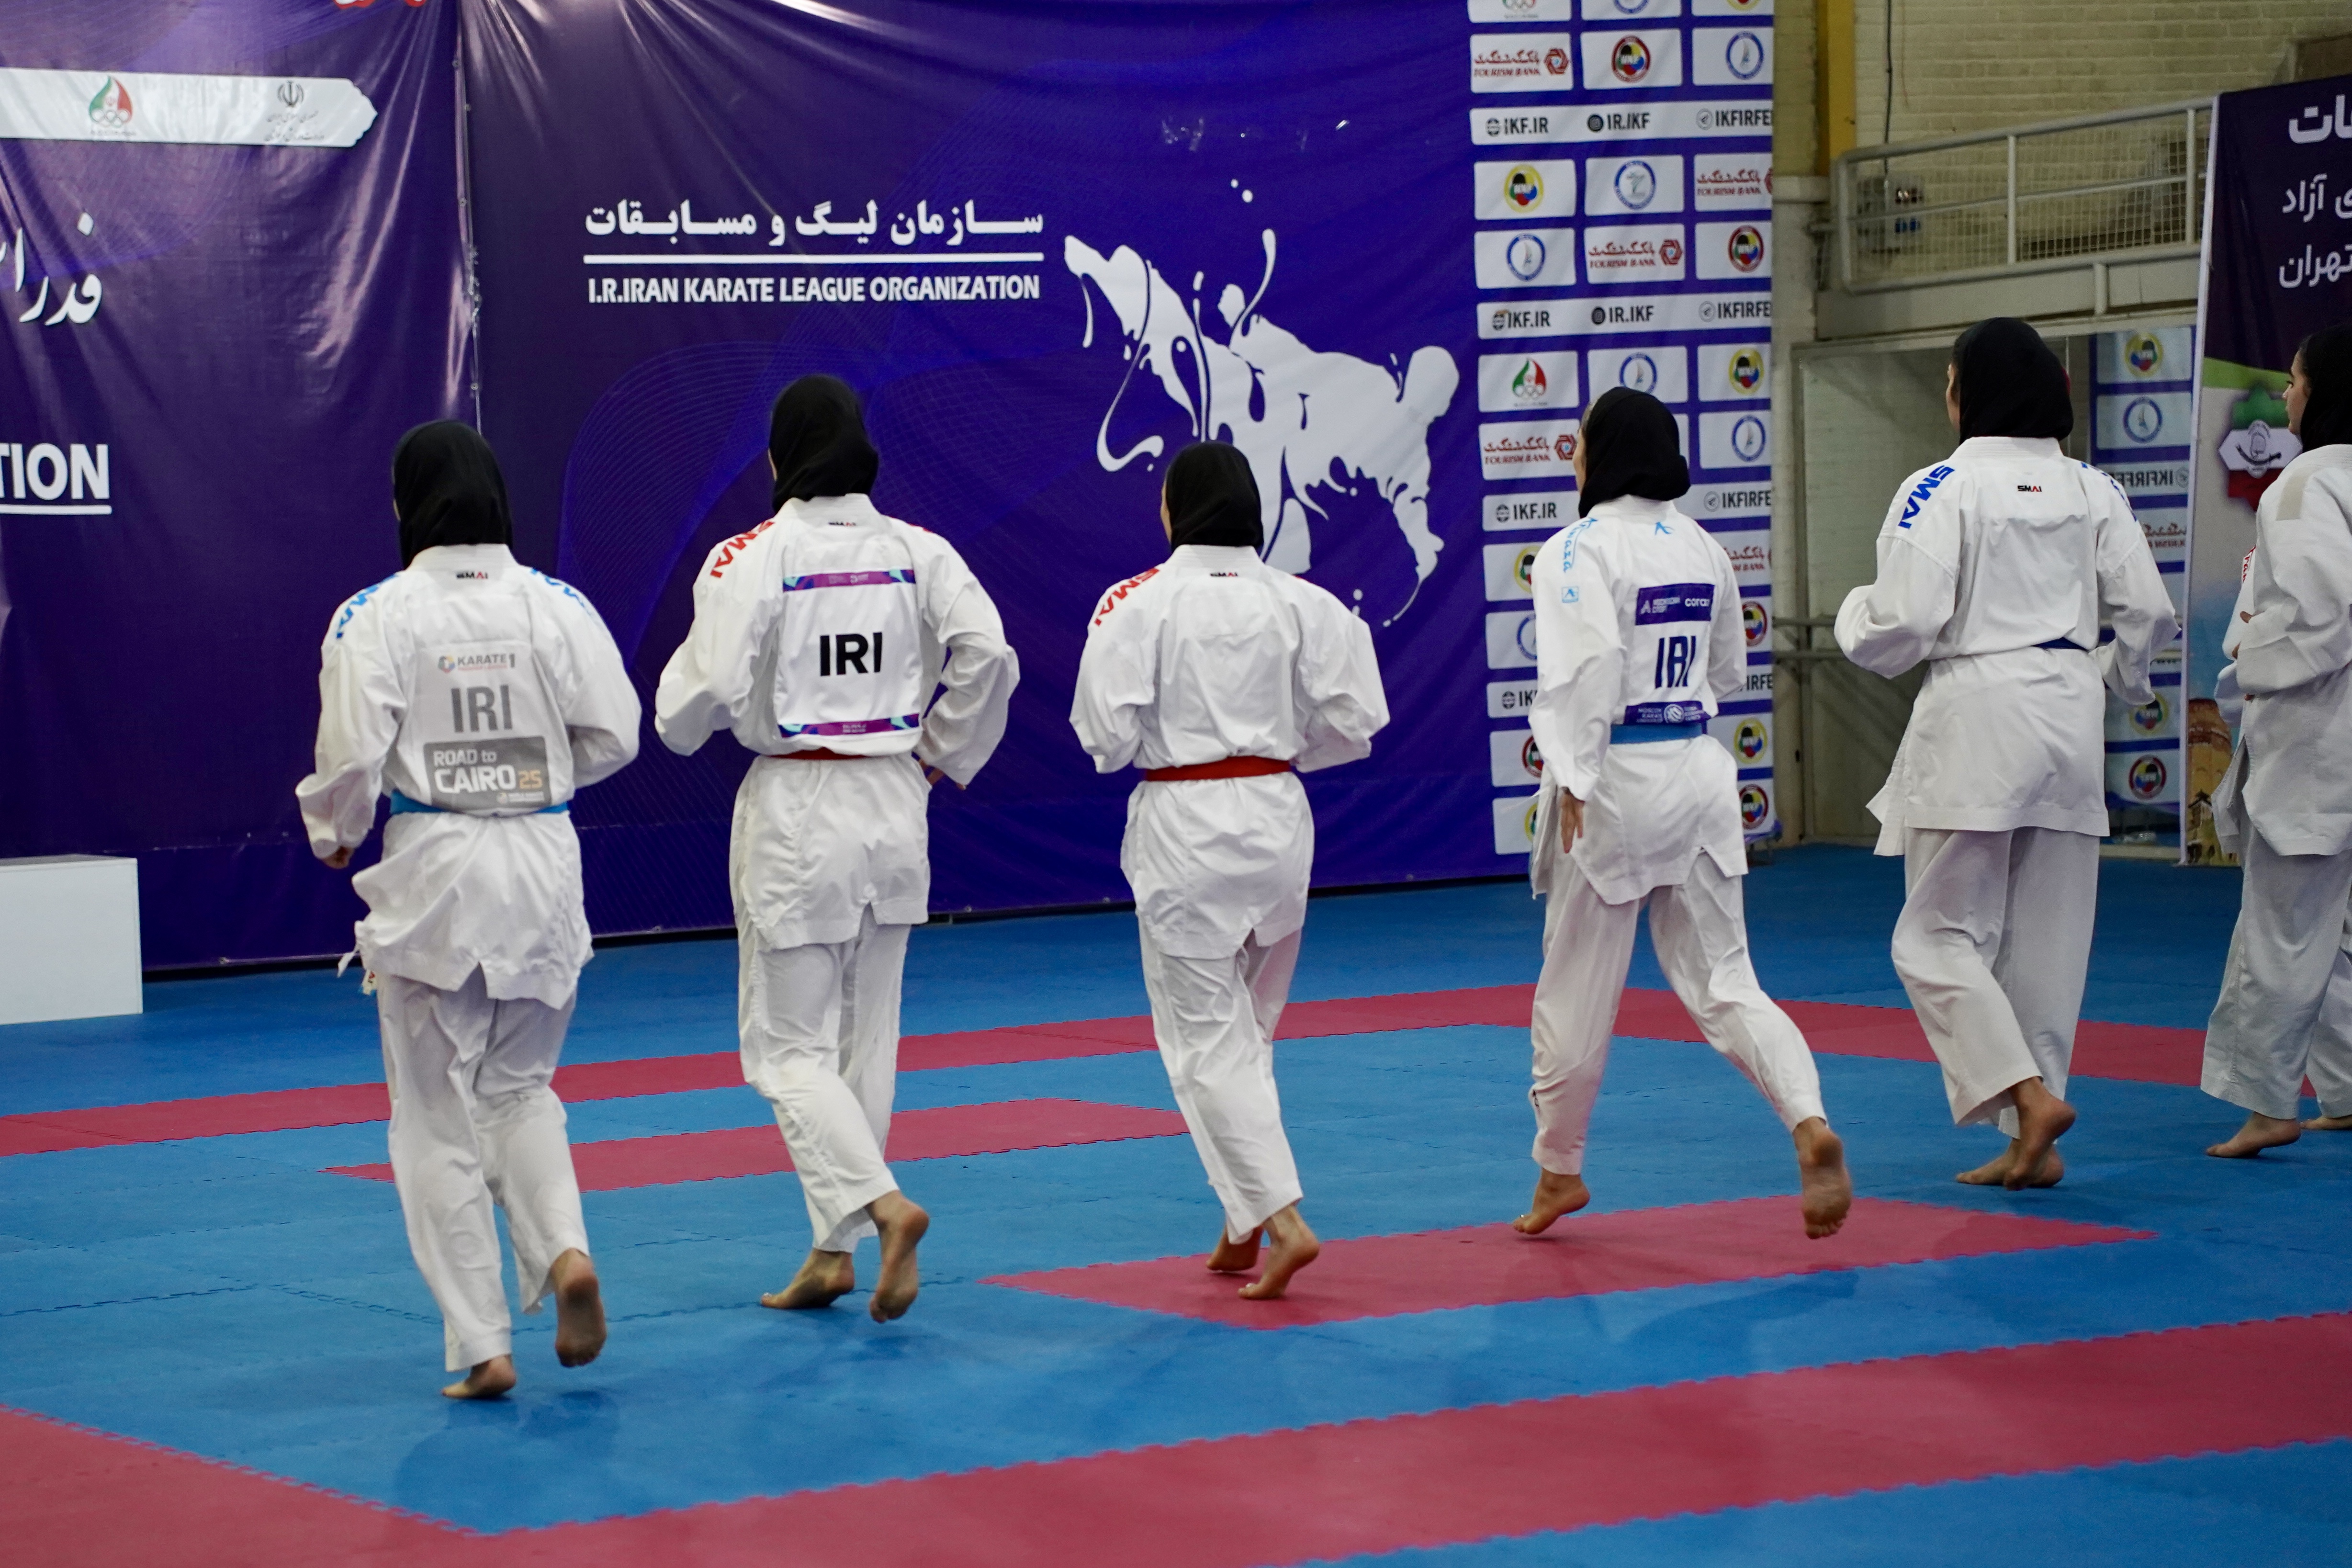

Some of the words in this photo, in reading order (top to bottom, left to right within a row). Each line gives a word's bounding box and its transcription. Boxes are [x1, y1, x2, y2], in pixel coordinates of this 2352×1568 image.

[1504, 116, 1548, 135] IKF.IR
[1607, 112, 1650, 130] IR.IKF
[2282, 172, 2328, 223] آزاد
[585, 199, 757, 244] مسابقات
[768, 214, 786, 246] و
[795, 199, 878, 244] لیگ
[890, 199, 1044, 246] سازمان
[0, 212, 102, 326] فدرا
[588, 277, 679, 304] I.R.IRAN
[684, 277, 775, 303] KARATE
[779, 277, 866, 302] LEAGUE
[869, 274, 1040, 302] ORGANIZATION
[1508, 310, 1551, 328] IKF.IR
[1609, 305, 1654, 323] IR.IKF
[1898, 465, 1956, 530] SMAI
[2017, 485, 2043, 493] SMAI
[1513, 502, 1557, 520] IKF.IR
[457, 653, 507, 666] KARATE
[819, 632, 883, 677] IRI
[1654, 635, 1696, 689] IRI
[450, 684, 513, 733] IRI
[433, 749, 478, 767] ROAD
[481, 750, 497, 763] to
[434, 764, 516, 795] CAIRO
[518, 769, 543, 789] 25
